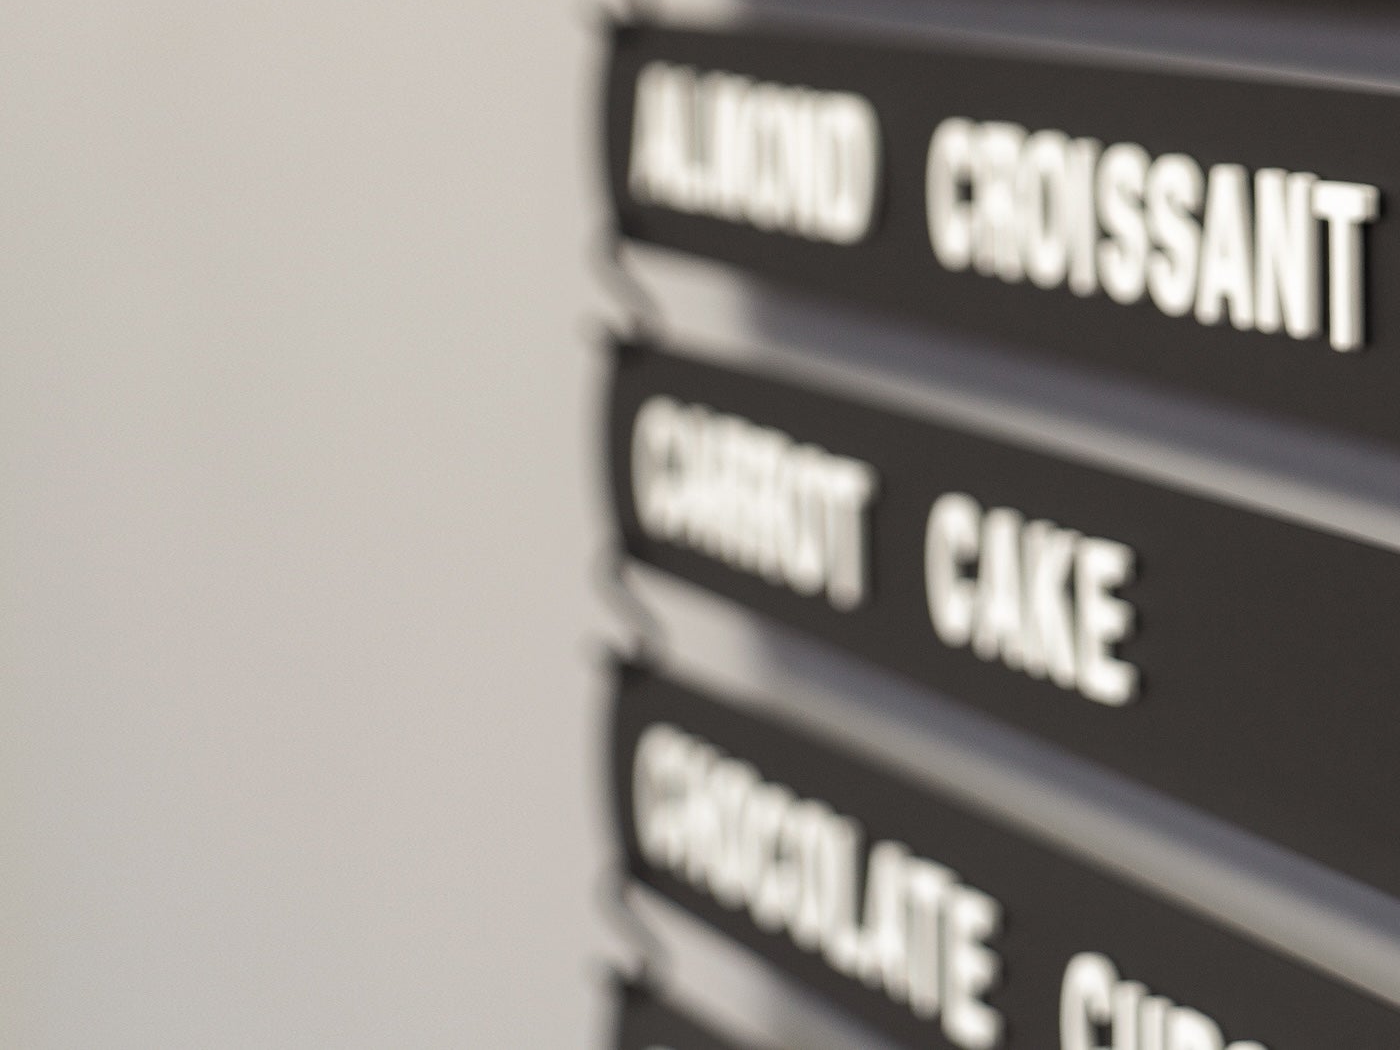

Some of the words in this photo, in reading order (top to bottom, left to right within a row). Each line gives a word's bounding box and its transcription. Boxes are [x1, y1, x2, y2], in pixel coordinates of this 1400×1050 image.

[632, 62, 878, 244] ALMOND
[926, 118, 1378, 352] CROISSANT
[632, 396, 874, 608] CARROT
[925, 493, 1135, 705] CAKE
[633, 724, 1000, 1049] CHOCOLATE
